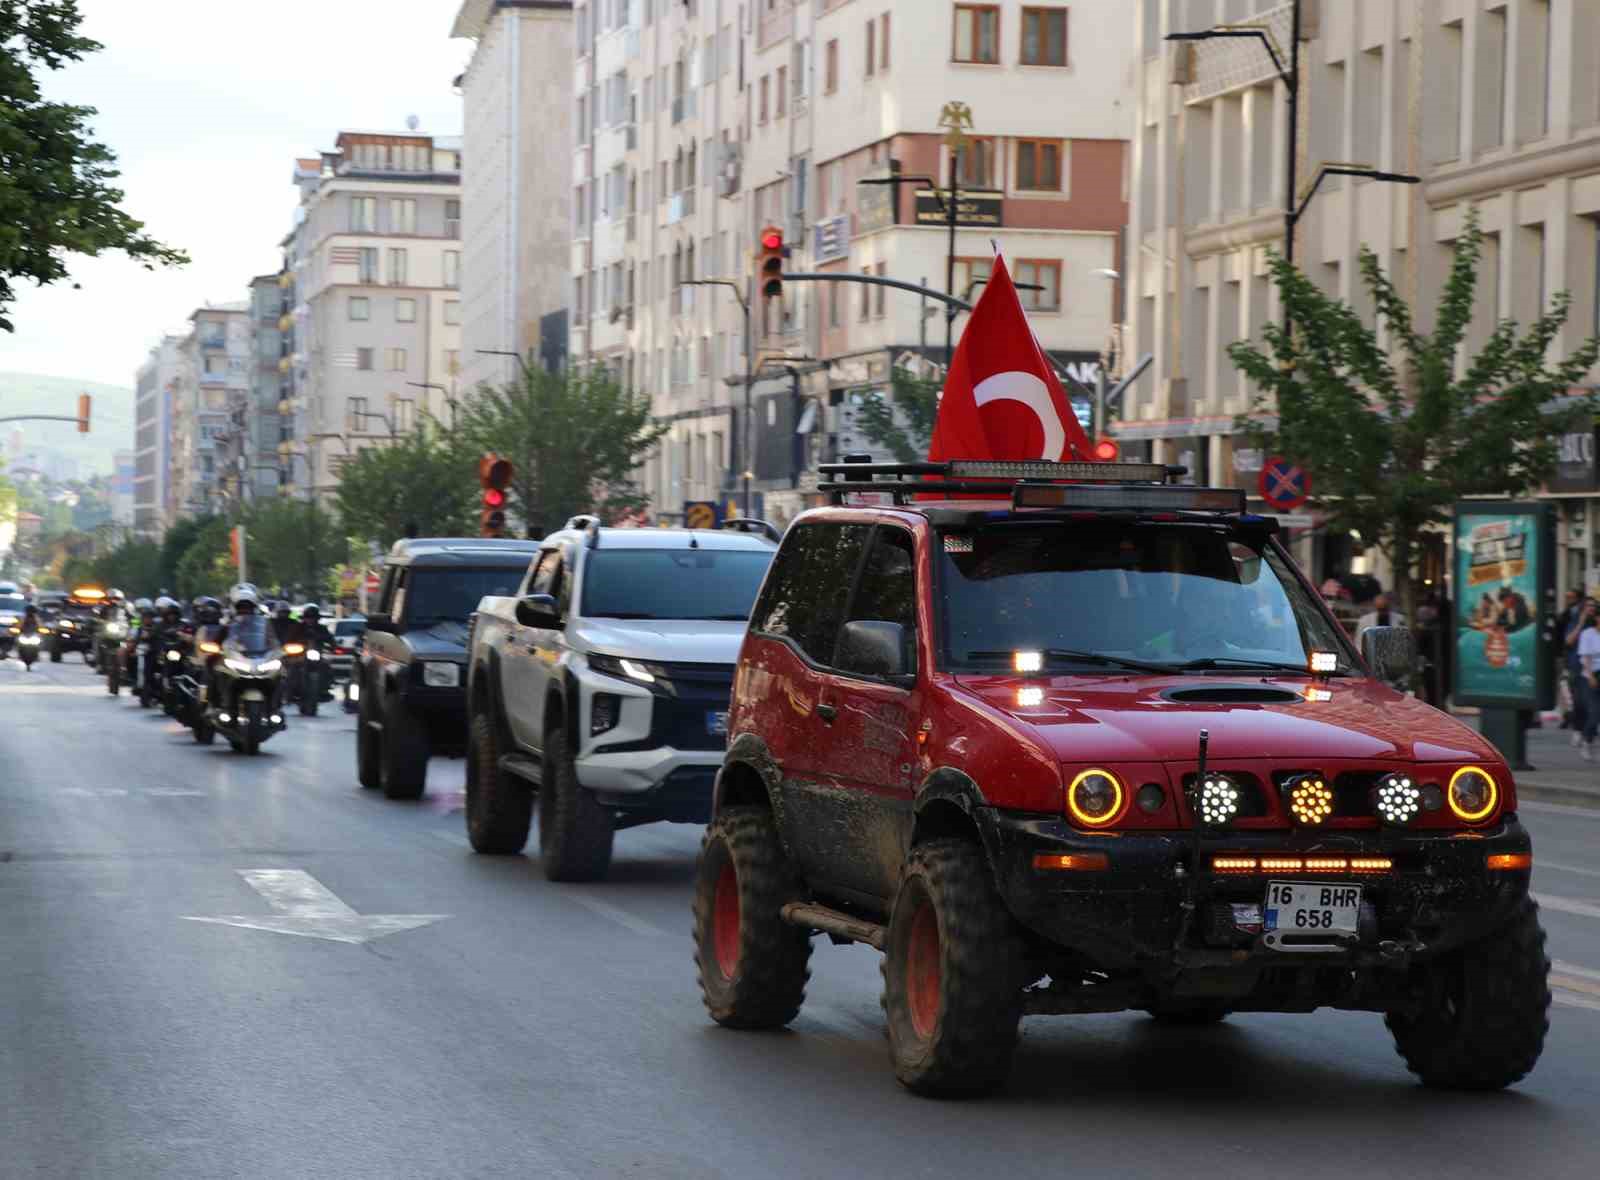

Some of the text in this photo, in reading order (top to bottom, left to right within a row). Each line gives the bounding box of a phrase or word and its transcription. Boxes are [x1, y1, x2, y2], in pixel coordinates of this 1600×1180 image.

[1271, 886, 1358, 907] 16 BHR
[1295, 909, 1333, 928] 658
